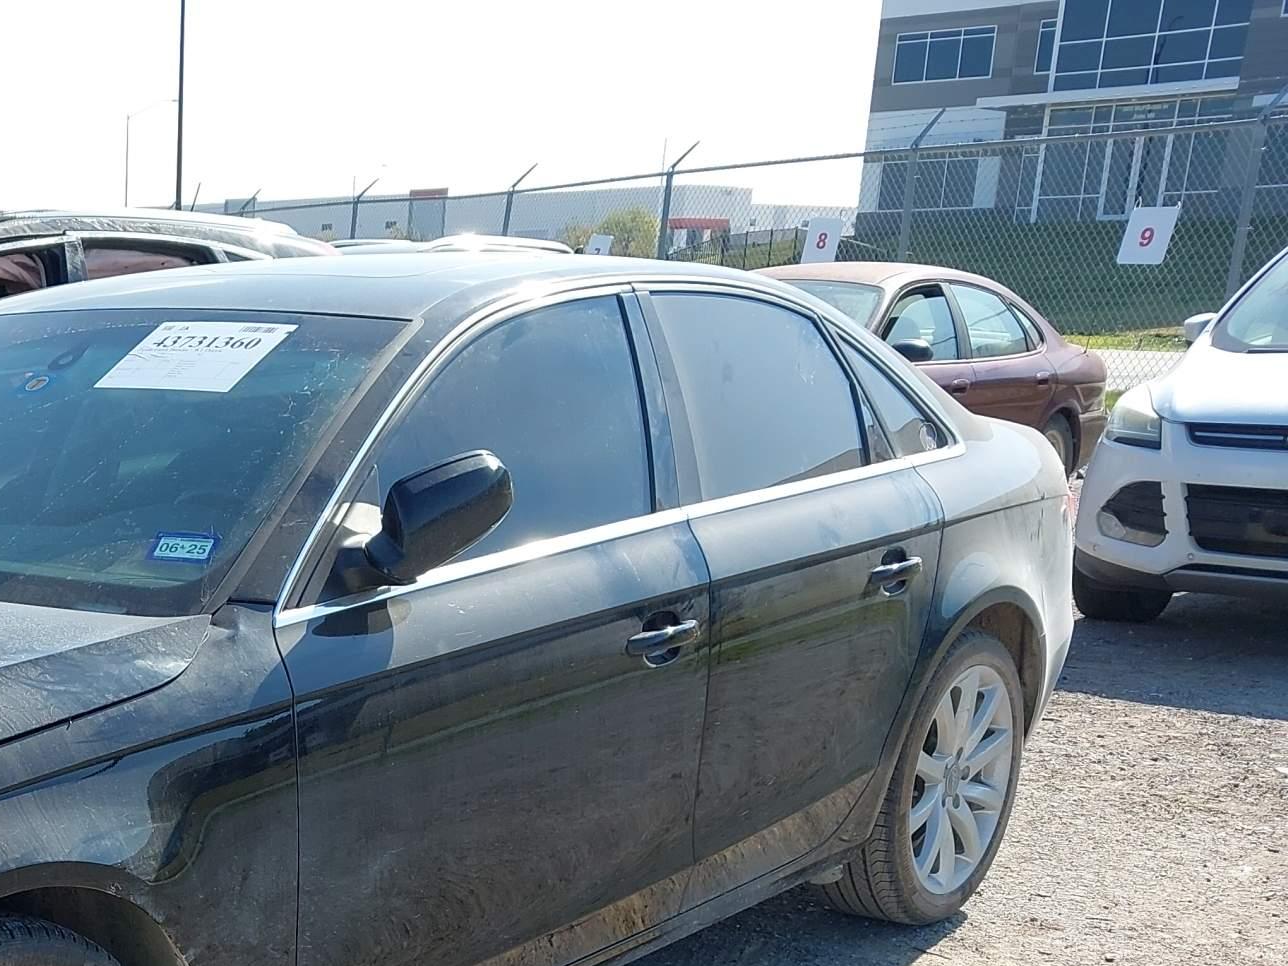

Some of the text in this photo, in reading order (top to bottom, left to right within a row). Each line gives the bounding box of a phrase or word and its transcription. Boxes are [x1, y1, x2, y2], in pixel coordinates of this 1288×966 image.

[816, 232, 828, 249] 8
[1139, 227, 1155, 247] 9
[153, 335, 262, 349] 43731360
[158, 542, 209, 555] 06 25
